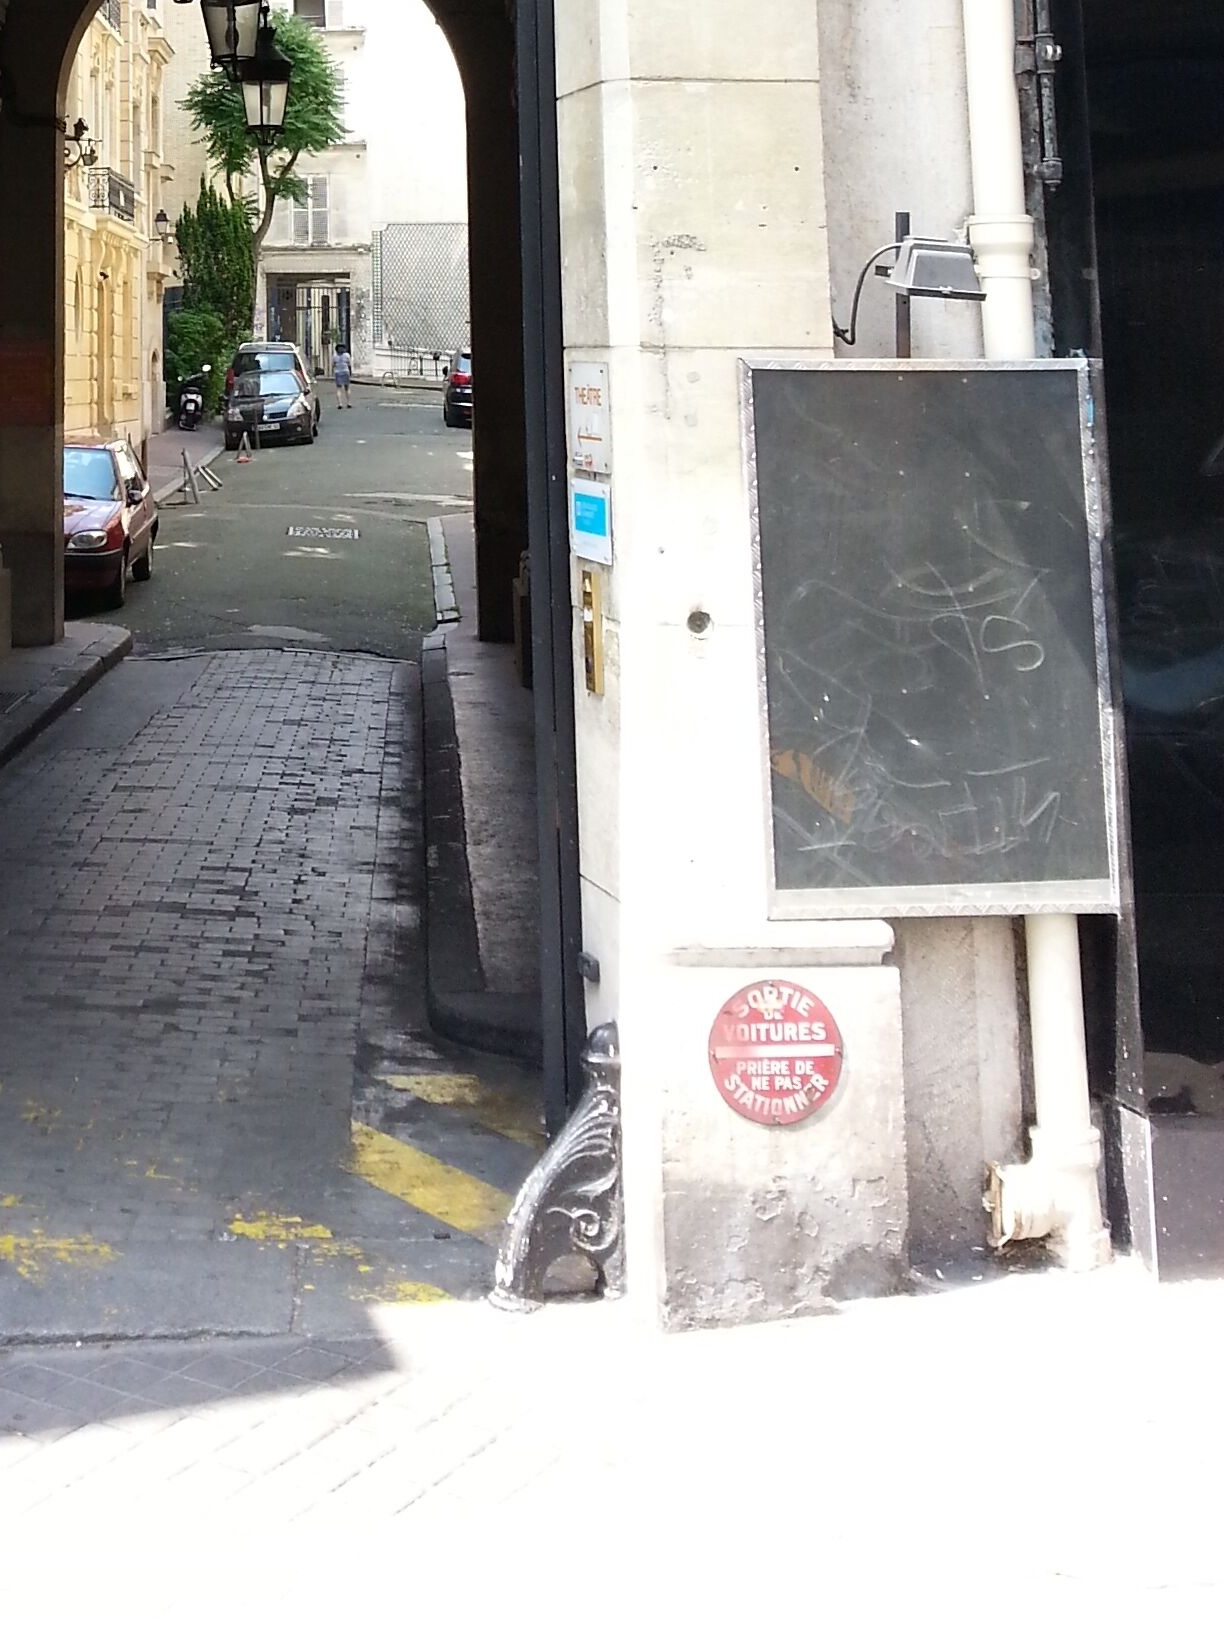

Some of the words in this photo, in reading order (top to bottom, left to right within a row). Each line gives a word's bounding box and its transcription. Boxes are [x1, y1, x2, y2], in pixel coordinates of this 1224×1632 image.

[732, 986, 816, 1018] SORTIE
[723, 1022, 827, 1042] VOITURES
[795, 1059, 815, 1075] DE
[751, 1075, 771, 1090] NE
[774, 1075, 802, 1090] PAS
